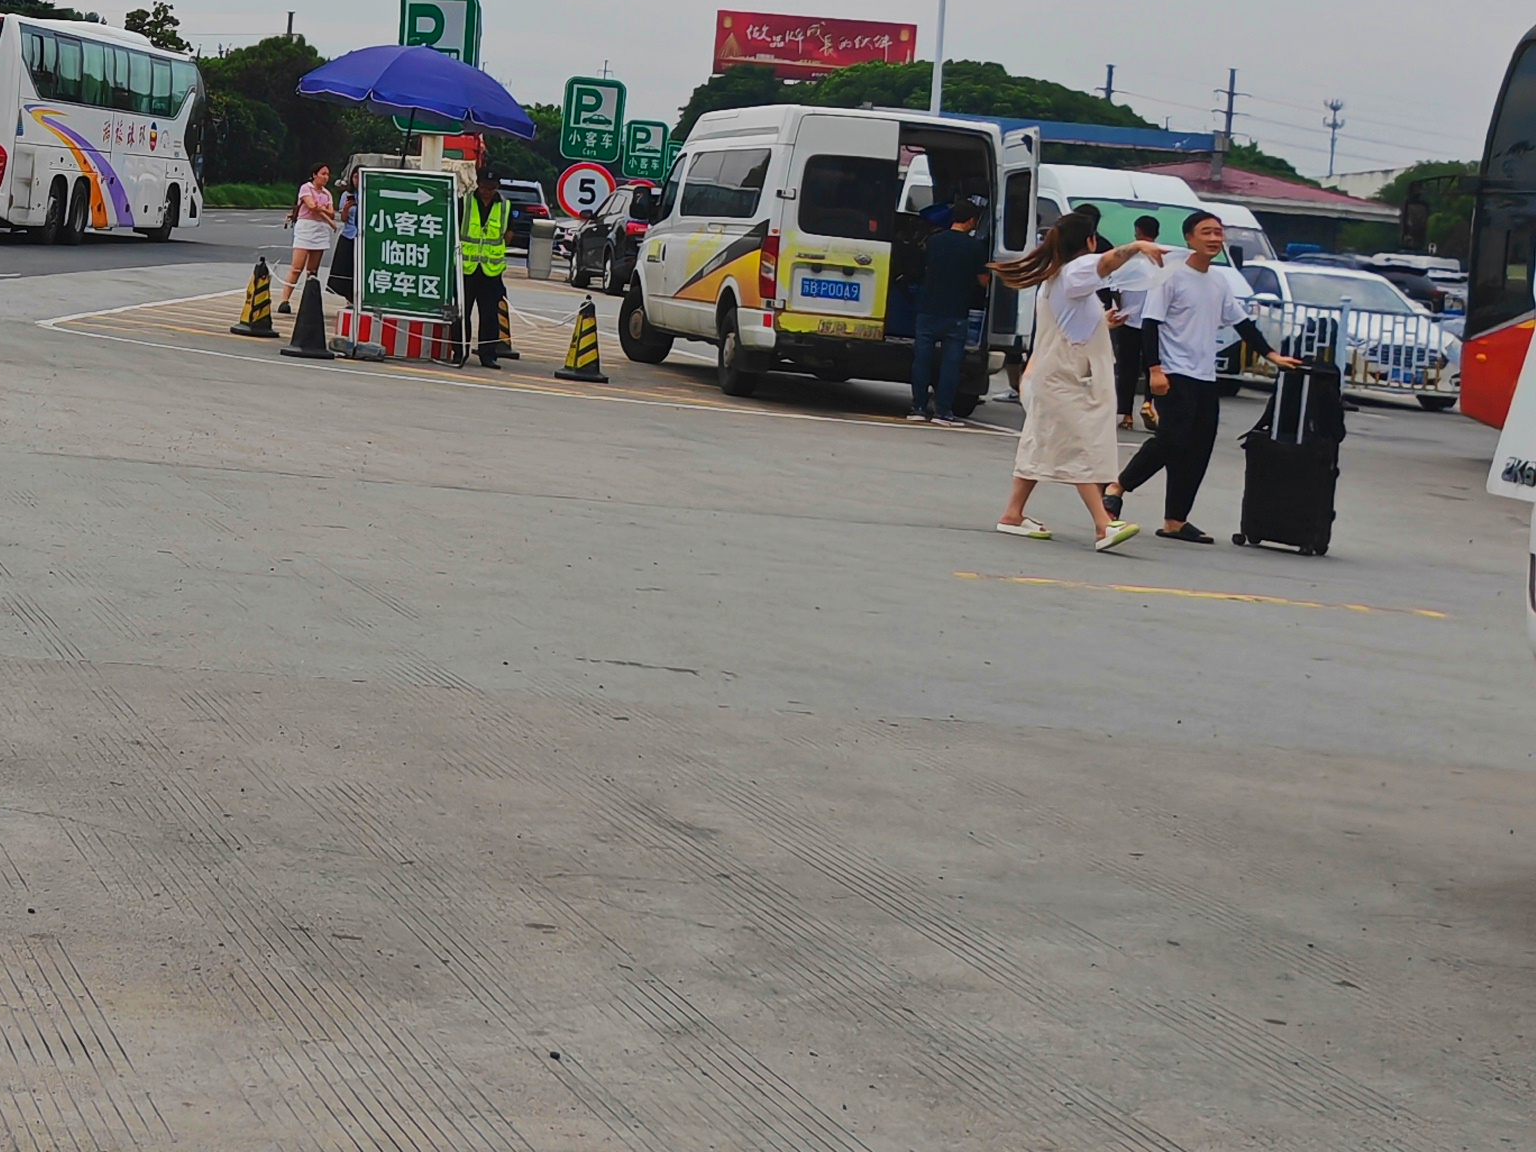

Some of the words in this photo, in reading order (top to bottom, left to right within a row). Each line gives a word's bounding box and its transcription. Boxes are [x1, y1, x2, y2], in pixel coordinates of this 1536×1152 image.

[408, 3, 445, 46] P
[573, 88, 603, 125] P
[568, 128, 614, 149] 小客车
[581, 148, 597, 157] Cars
[631, 127, 652, 153] P
[628, 156, 661, 170] 小客车
[577, 178, 596, 205] 5
[369, 209, 444, 239] 小客车
[381, 239, 431, 268] 临时
[368, 268, 441, 300] 停车区
